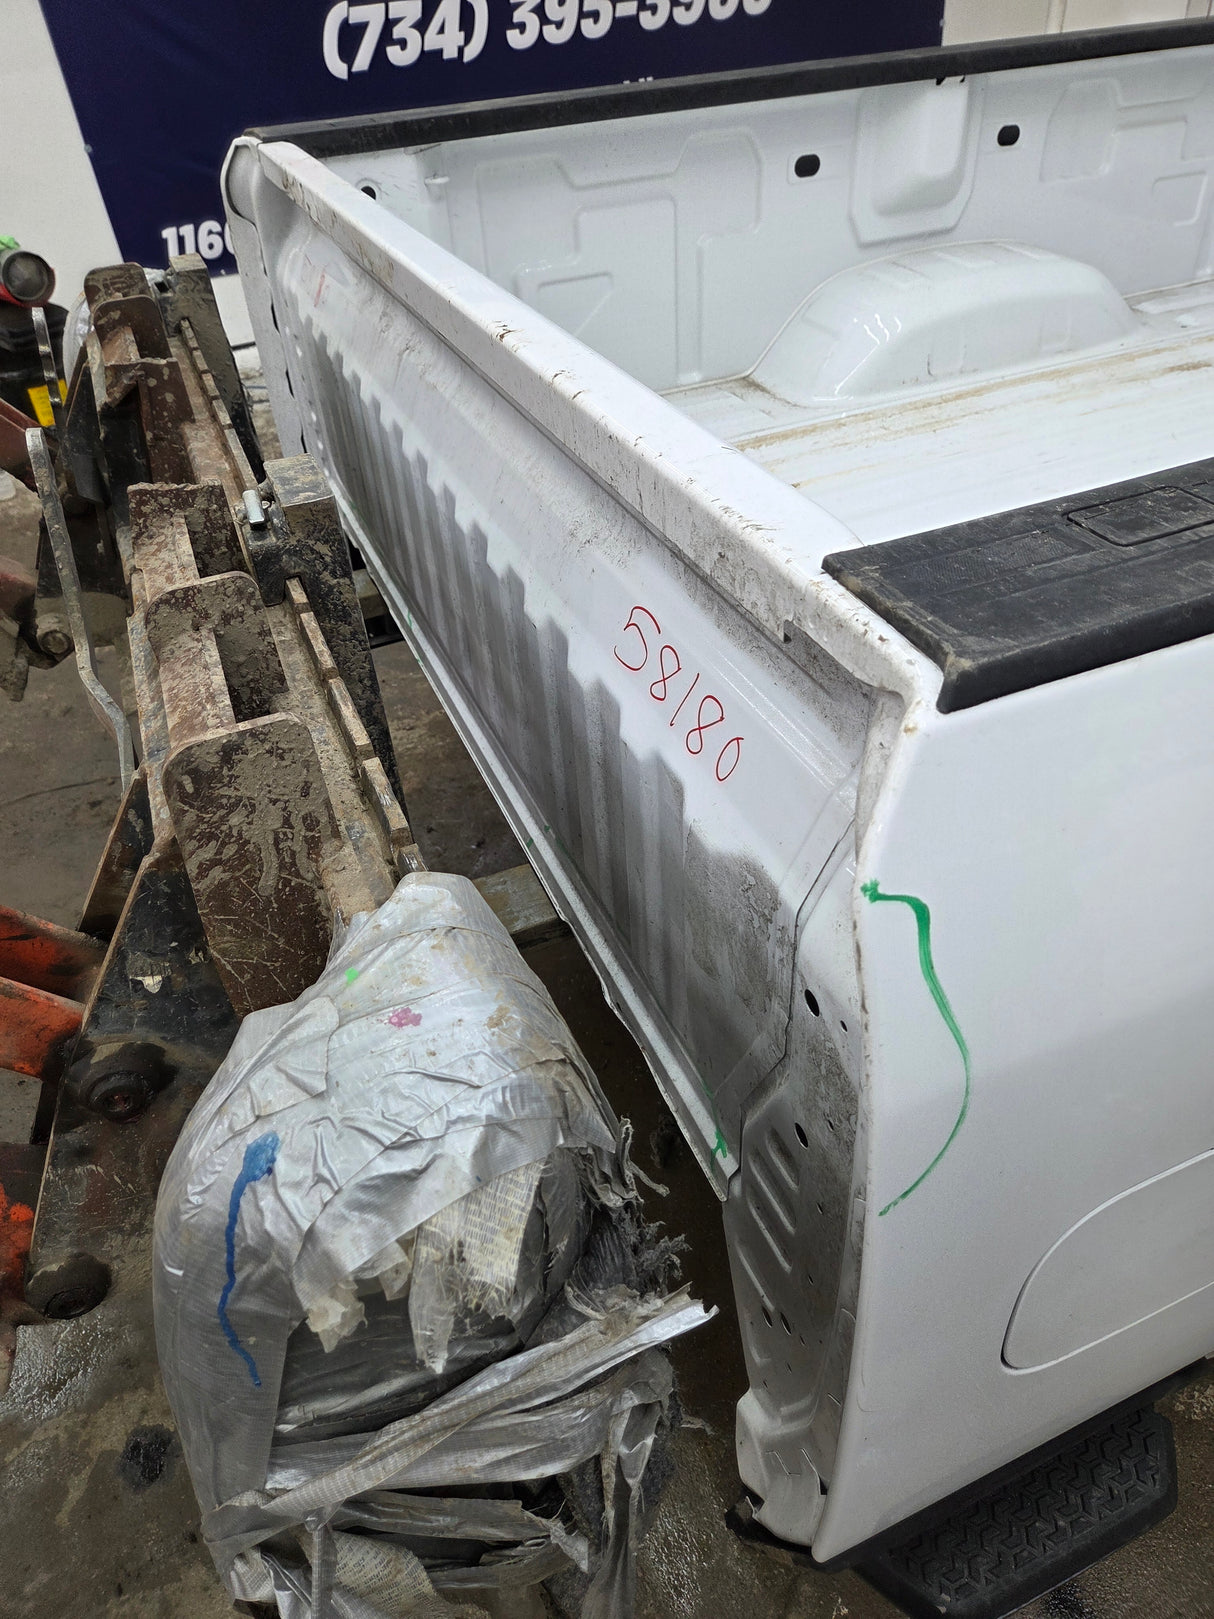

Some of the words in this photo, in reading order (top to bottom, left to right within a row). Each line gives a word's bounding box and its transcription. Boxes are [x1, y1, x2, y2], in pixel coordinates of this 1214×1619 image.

[322, 0, 489, 81] (734)
[505, 0, 772, 50] 395-3
[613, 605, 745, 782] 58180
